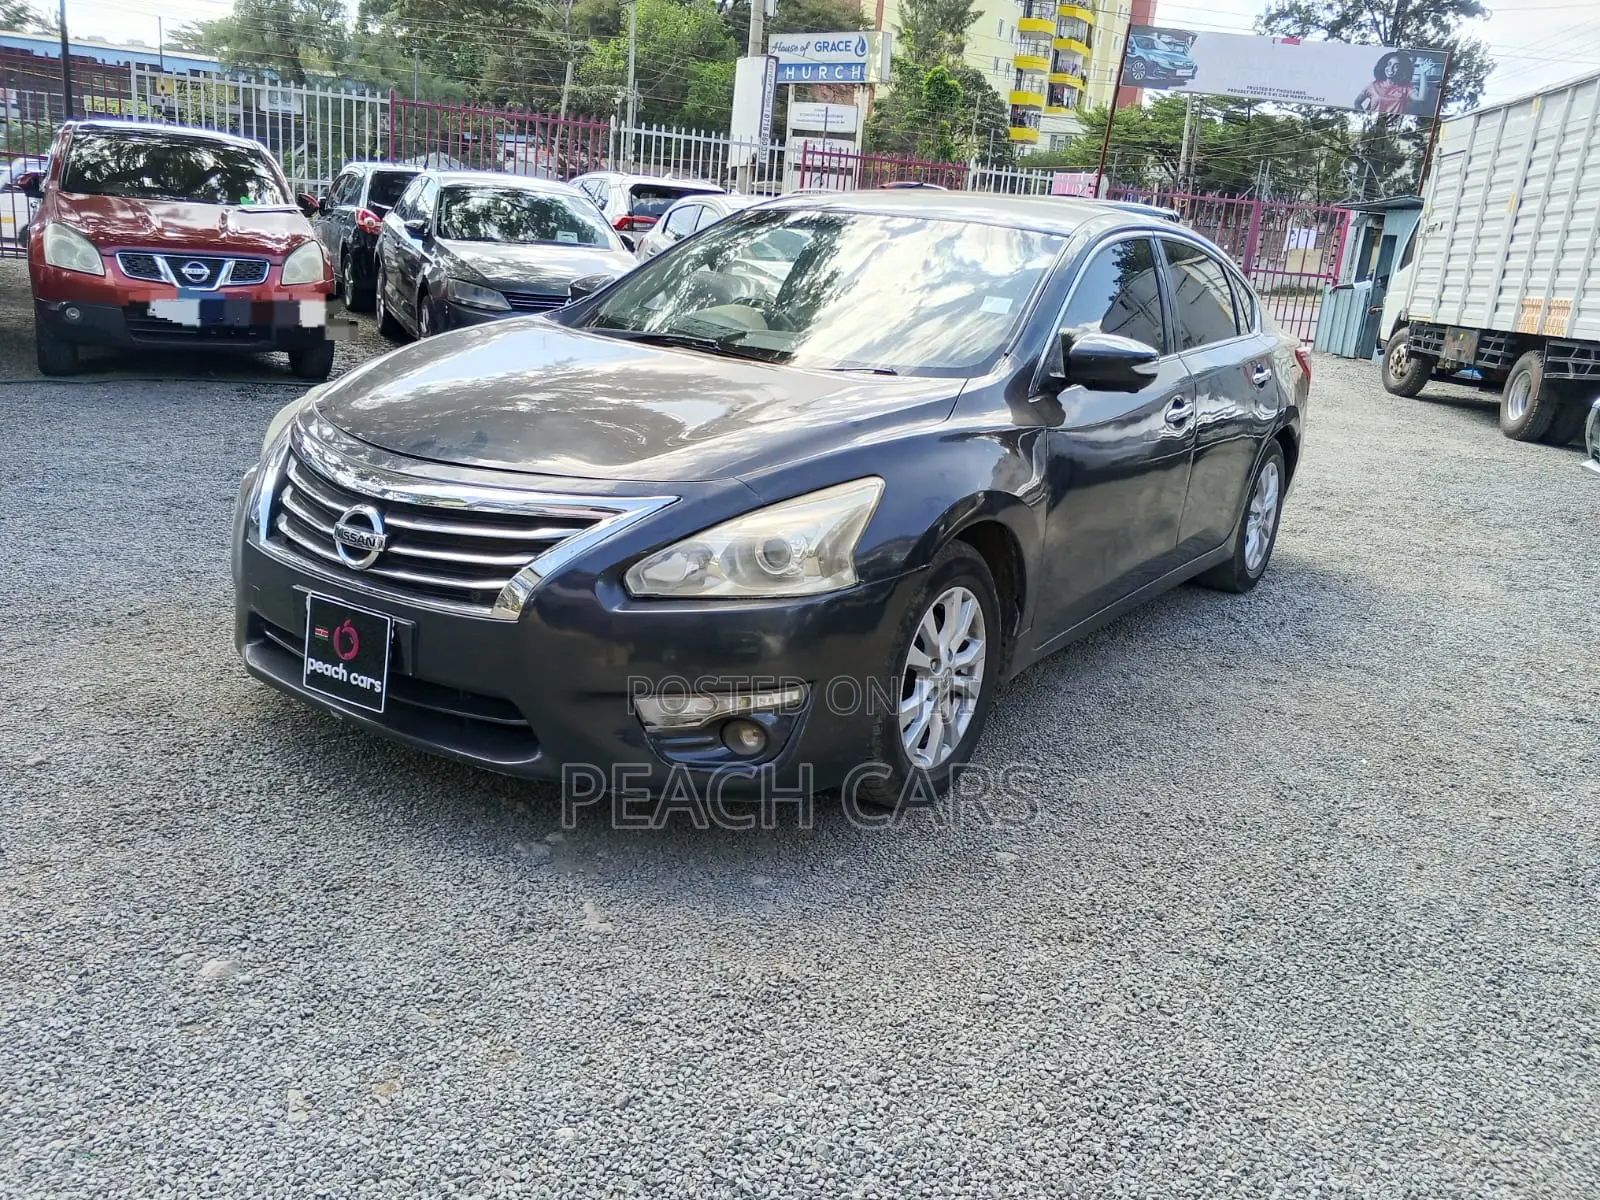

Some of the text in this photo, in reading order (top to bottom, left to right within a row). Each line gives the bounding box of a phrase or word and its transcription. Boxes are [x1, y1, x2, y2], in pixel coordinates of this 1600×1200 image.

[770, 40, 852, 57] House of GRACE
[785, 65, 861, 81] HURCH
[333, 527, 377, 548] NISSAN
[307, 657, 382, 693] peach cars
